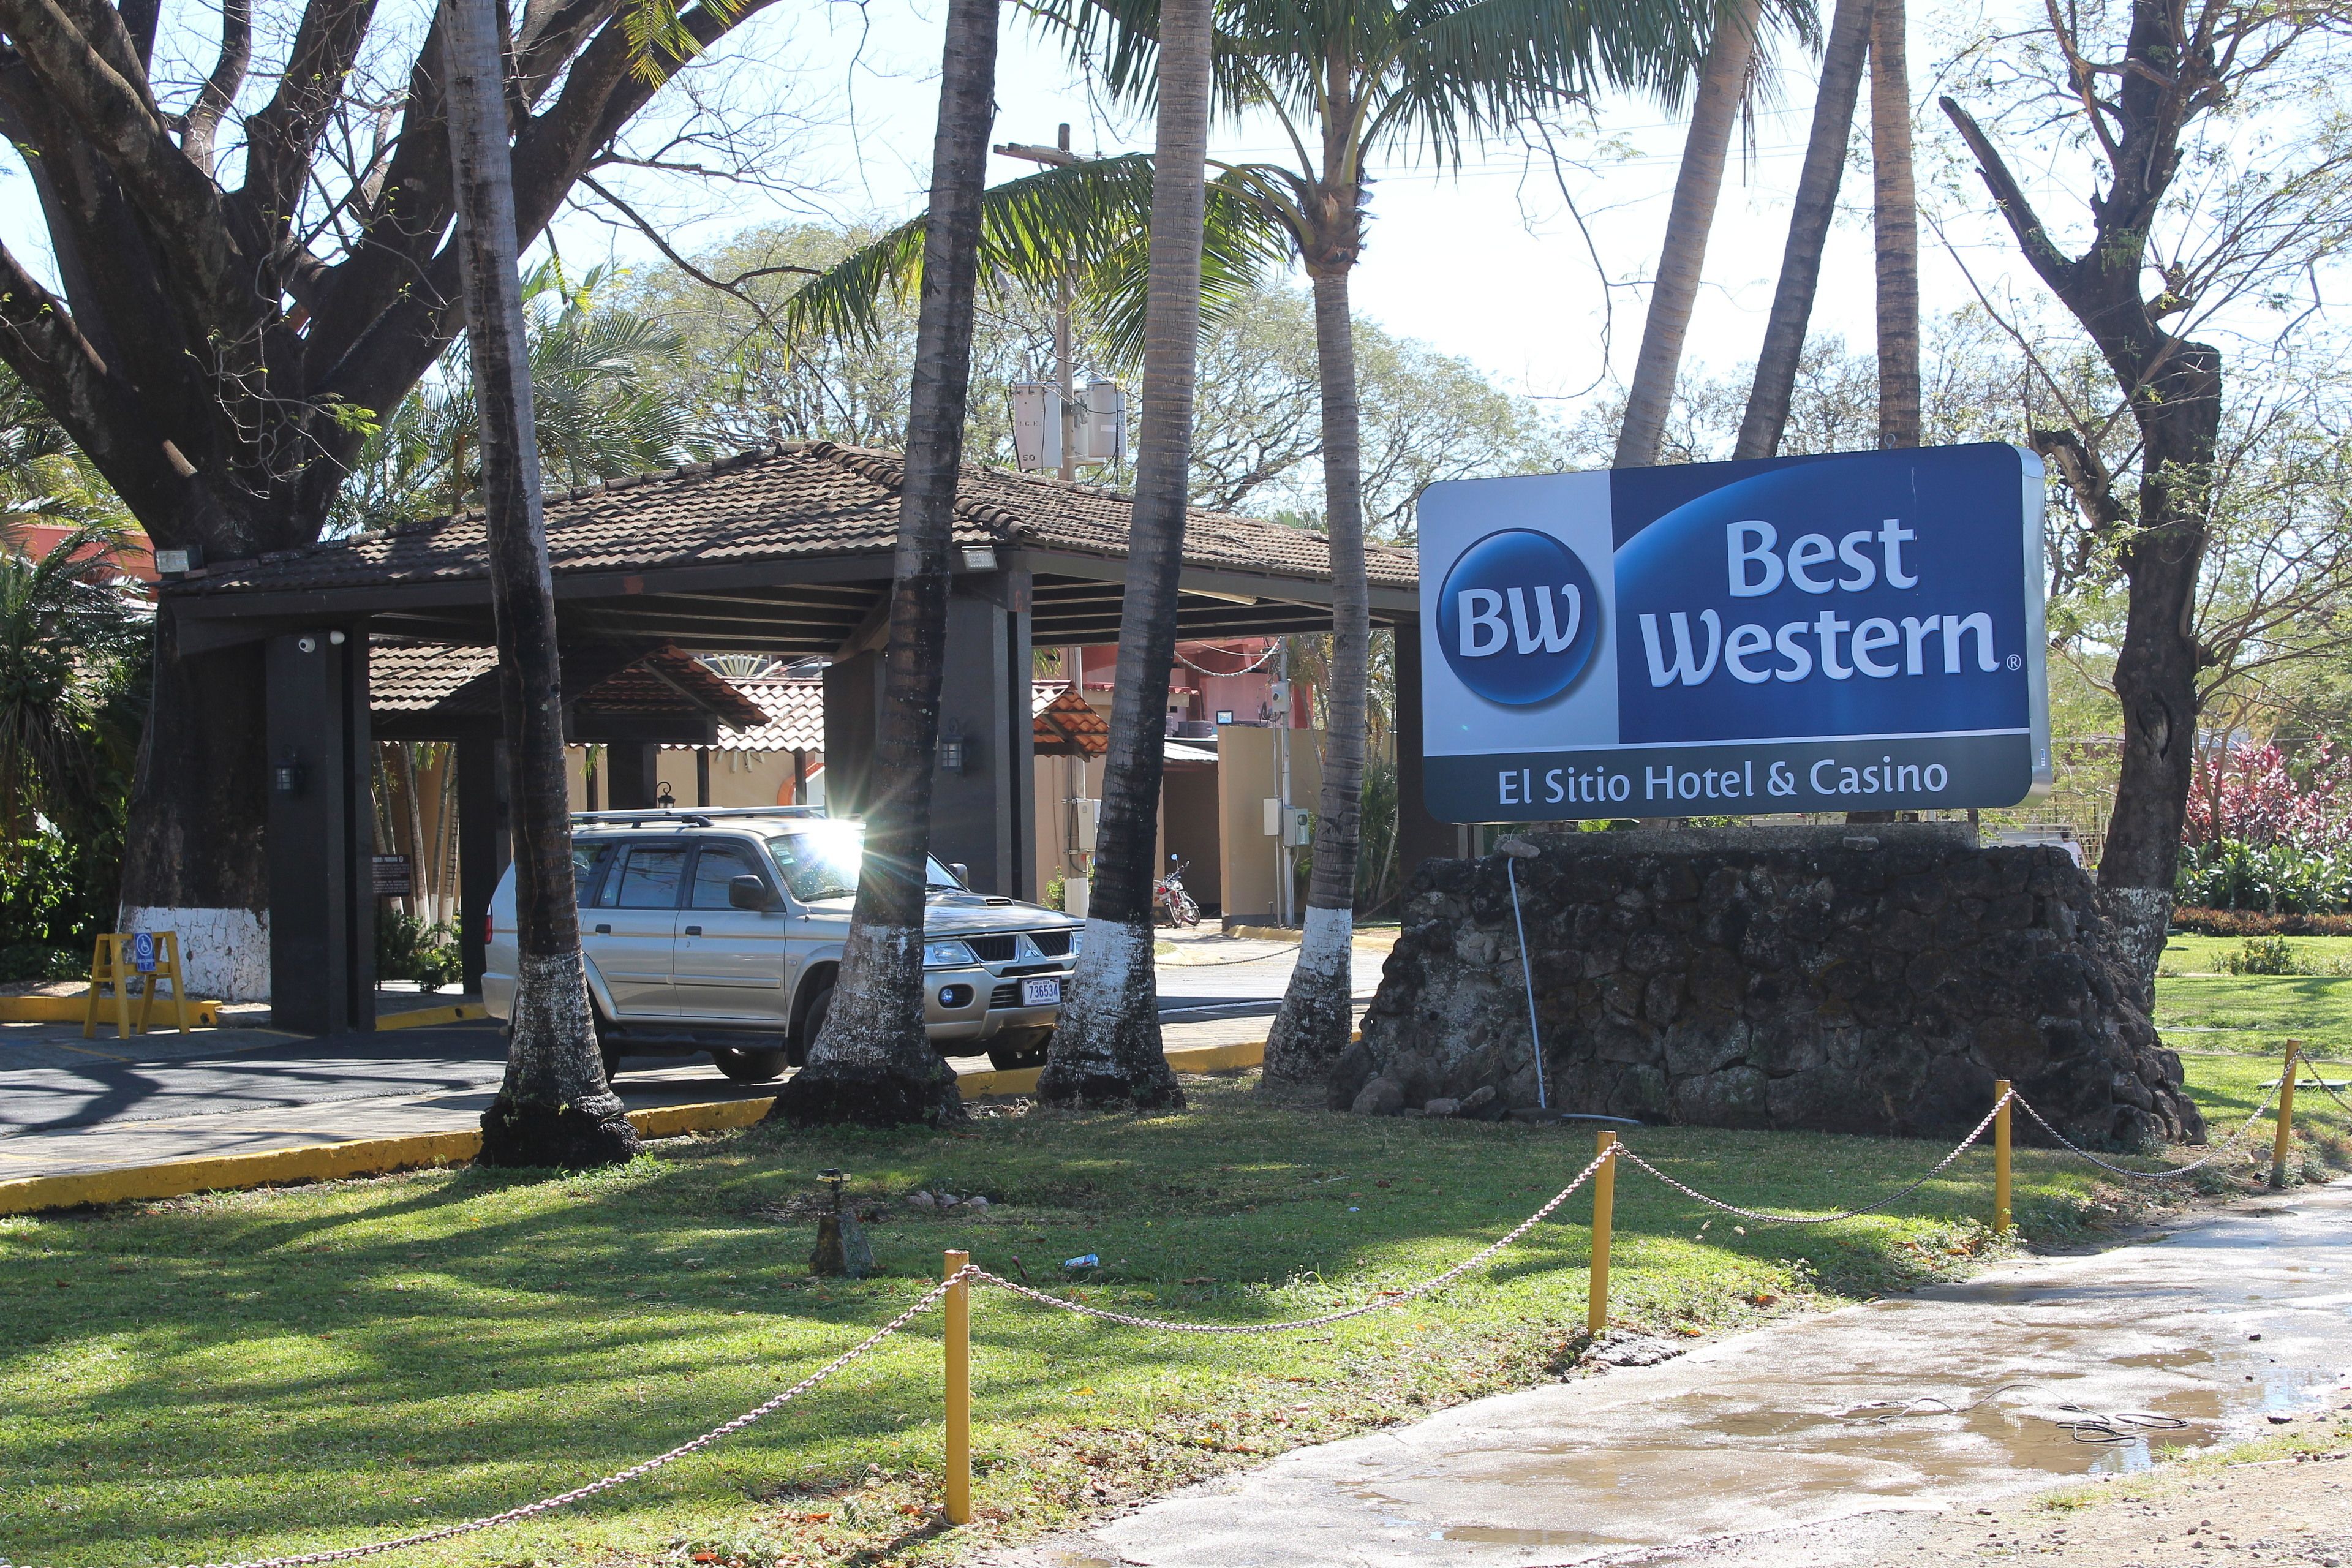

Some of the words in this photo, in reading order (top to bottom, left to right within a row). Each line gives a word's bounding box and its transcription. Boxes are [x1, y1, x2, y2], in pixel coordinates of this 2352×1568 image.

[1727, 519, 1918, 597] Best
[1458, 584, 1581, 658] BW
[1639, 608, 2000, 687] Western
[1499, 769, 1532, 805] El
[1545, 766, 1630, 804] Sitio
[1646, 761, 1755, 800] Hotel
[1767, 760, 1798, 796] &
[1809, 755, 1948, 795] Casino
[1029, 984, 1058, 999] 736534
